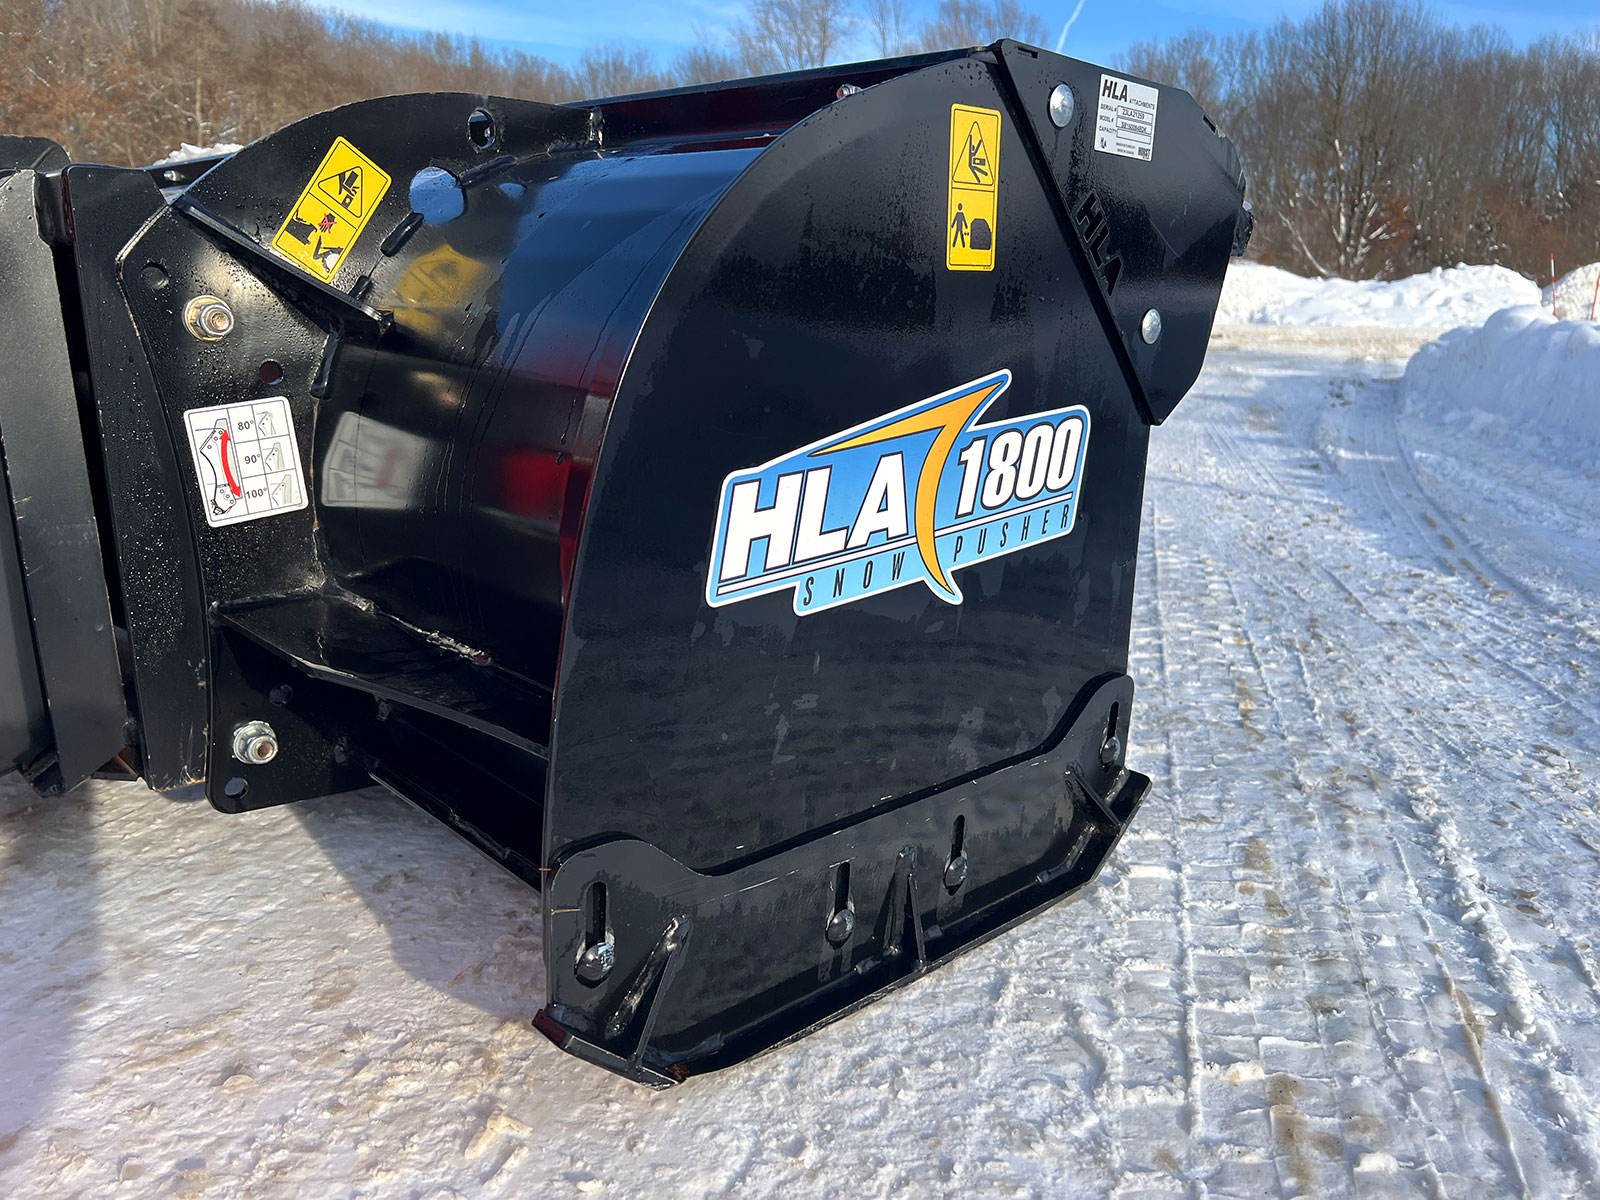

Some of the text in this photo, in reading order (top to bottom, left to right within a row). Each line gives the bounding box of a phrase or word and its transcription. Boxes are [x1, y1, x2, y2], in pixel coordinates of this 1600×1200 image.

[1102, 79, 1128, 102] HLA
[1076, 190, 1123, 296] HLA
[238, 419, 254, 431] 80°
[244, 453, 261, 465] 90°
[245, 487, 268, 499] 100°
[719, 415, 1084, 583] HLA 1800
[803, 504, 1070, 606] SNOW PUSHER
